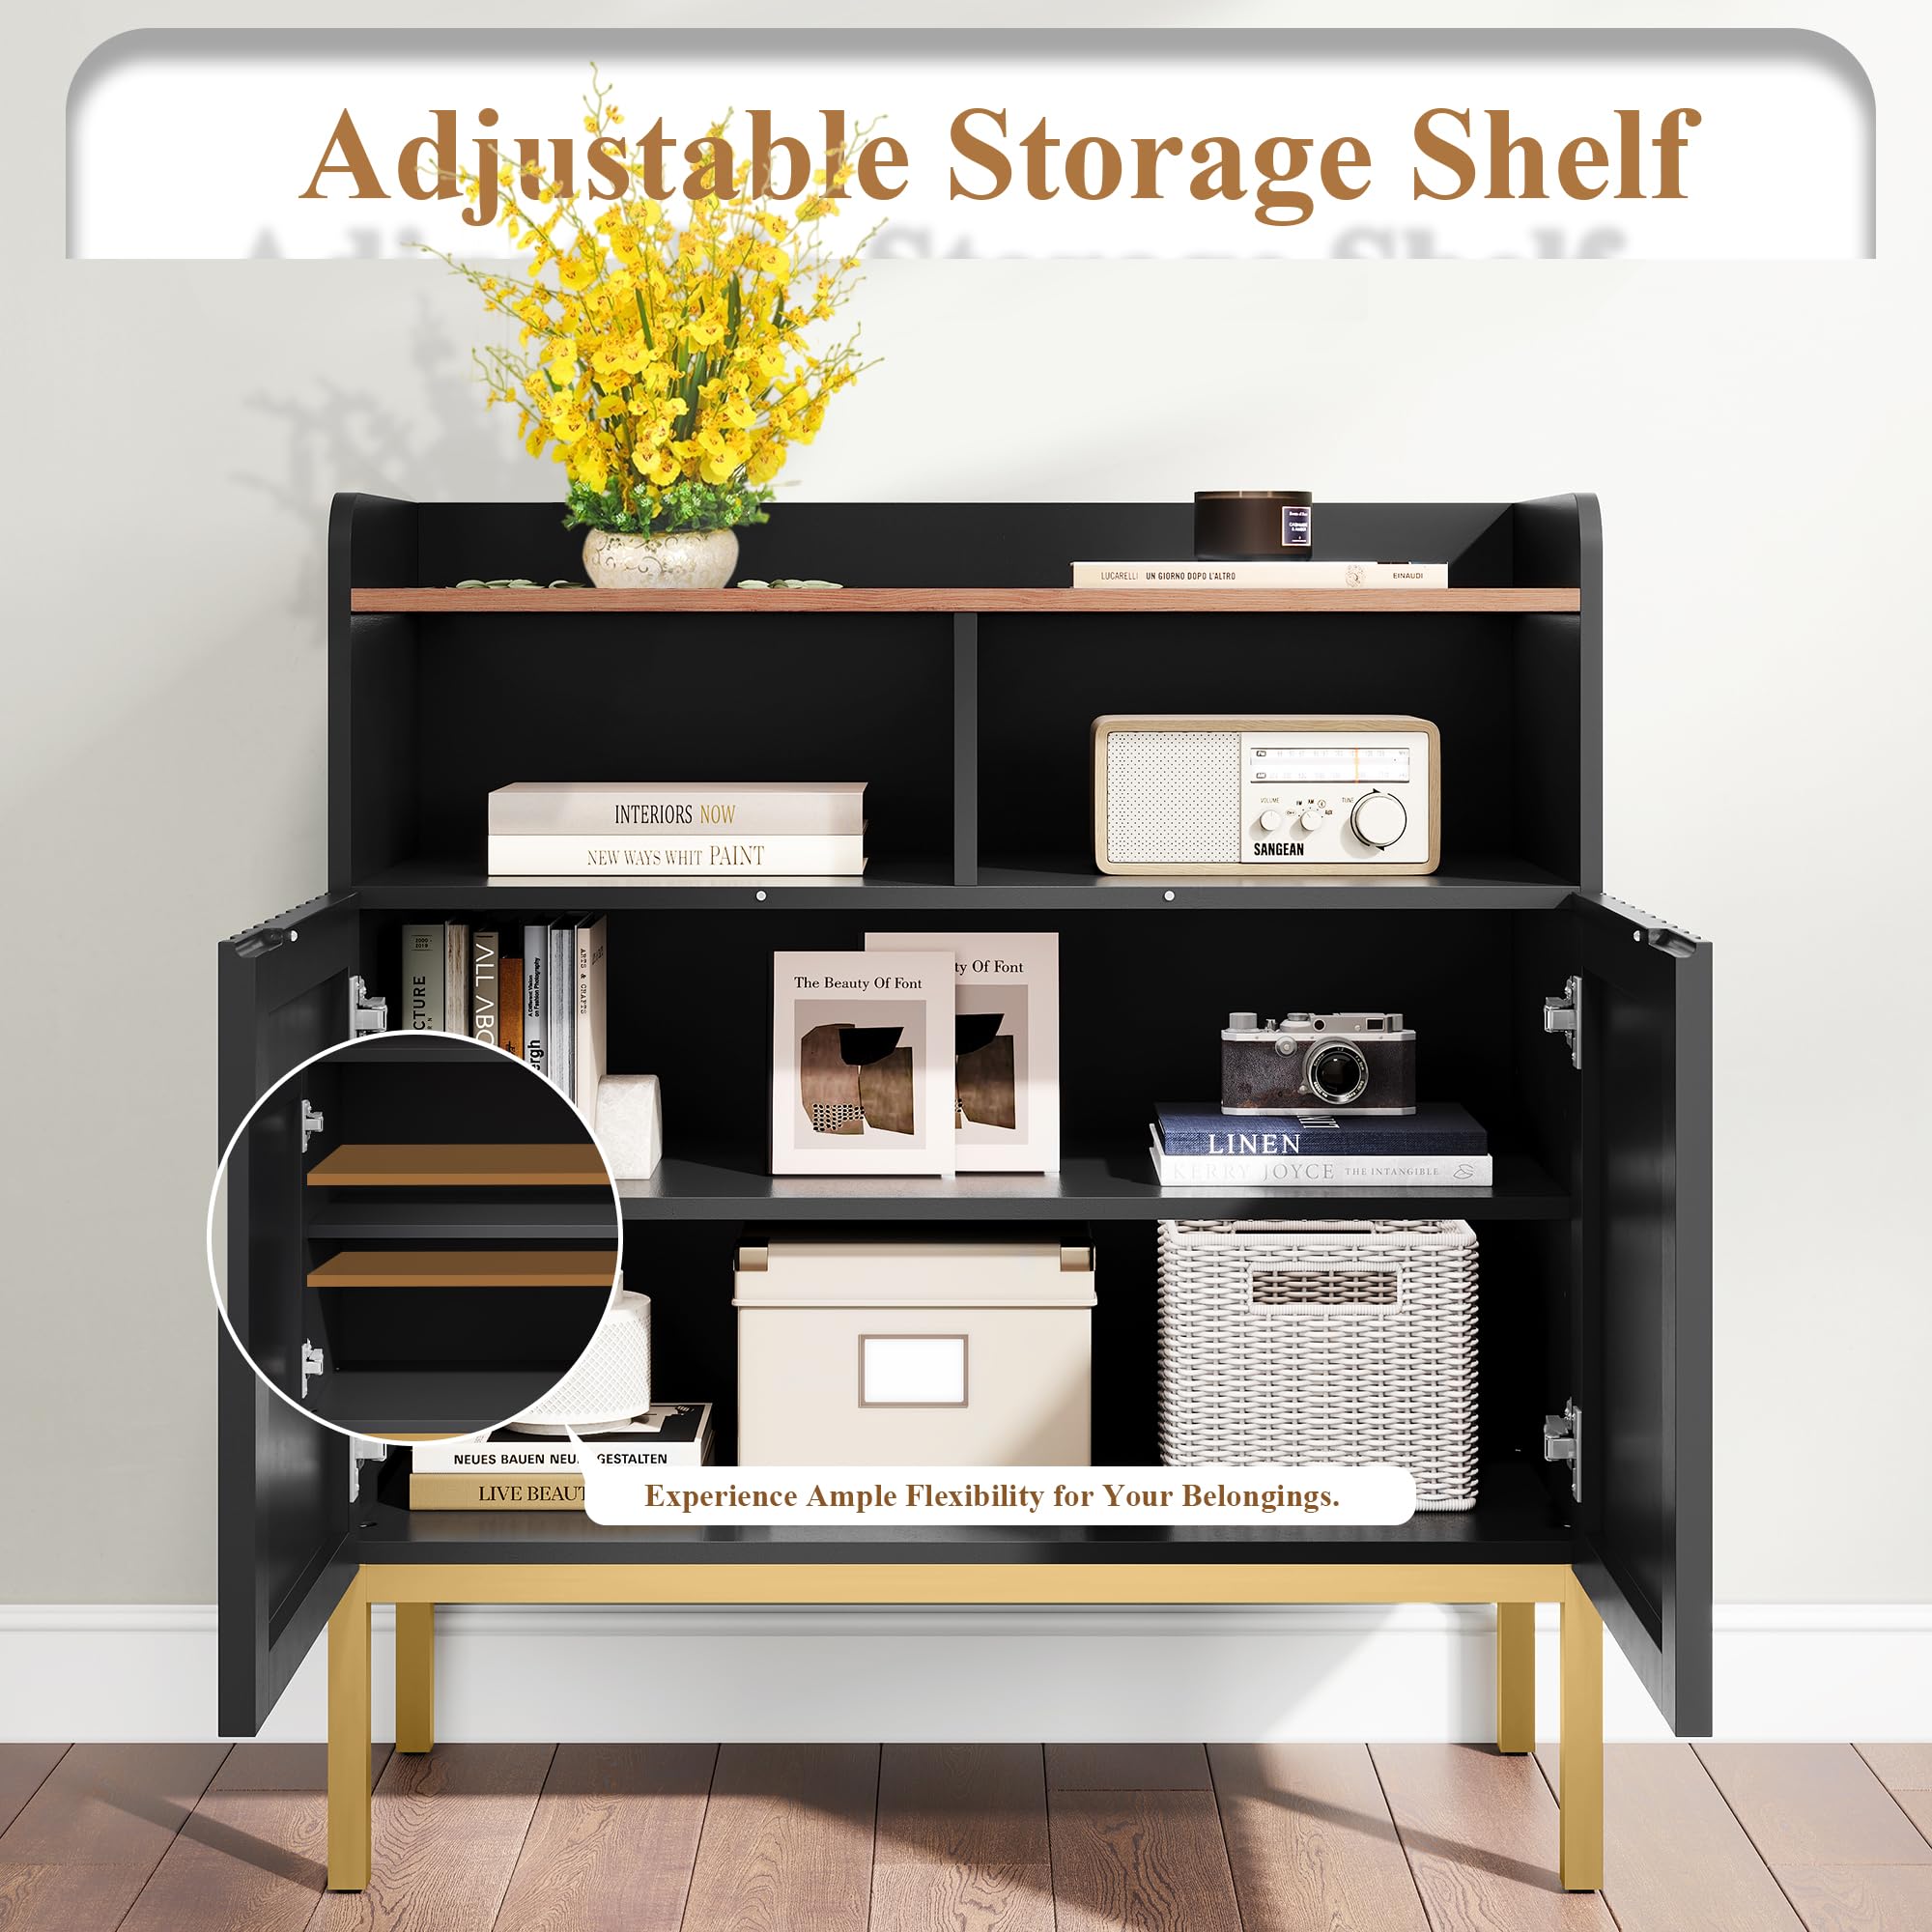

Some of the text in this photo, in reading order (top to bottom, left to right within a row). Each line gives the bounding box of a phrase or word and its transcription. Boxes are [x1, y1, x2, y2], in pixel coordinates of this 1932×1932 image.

[1100, 571, 1139, 581] LUCARELLI
[1146, 572, 1156, 581] UN
[1157, 571, 1185, 581] GIORNO
[1187, 571, 1208, 581] DOPO
[1208, 571, 1236, 581] L'ALTRO
[614, 804, 736, 825] INTERIORS NOW
[587, 845, 765, 867] NEW WAYS WHIT PAINT
[1254, 842, 1304, 857] SANGEAN
[475, 943, 495, 987] ALL
[972, 959, 991, 974] Of
[993, 959, 1025, 974] Font
[794, 977, 923, 992] The Beauty Of Font
[1208, 1134, 1300, 1154] LINEN
[1174, 1163, 1439, 1180] KERRY JOYCE THE INTANGIBLE
[453, 1453, 668, 1465] NEUES BAUEN NEU GESTALTEN
[478, 1485, 523, 1501] LIVE
